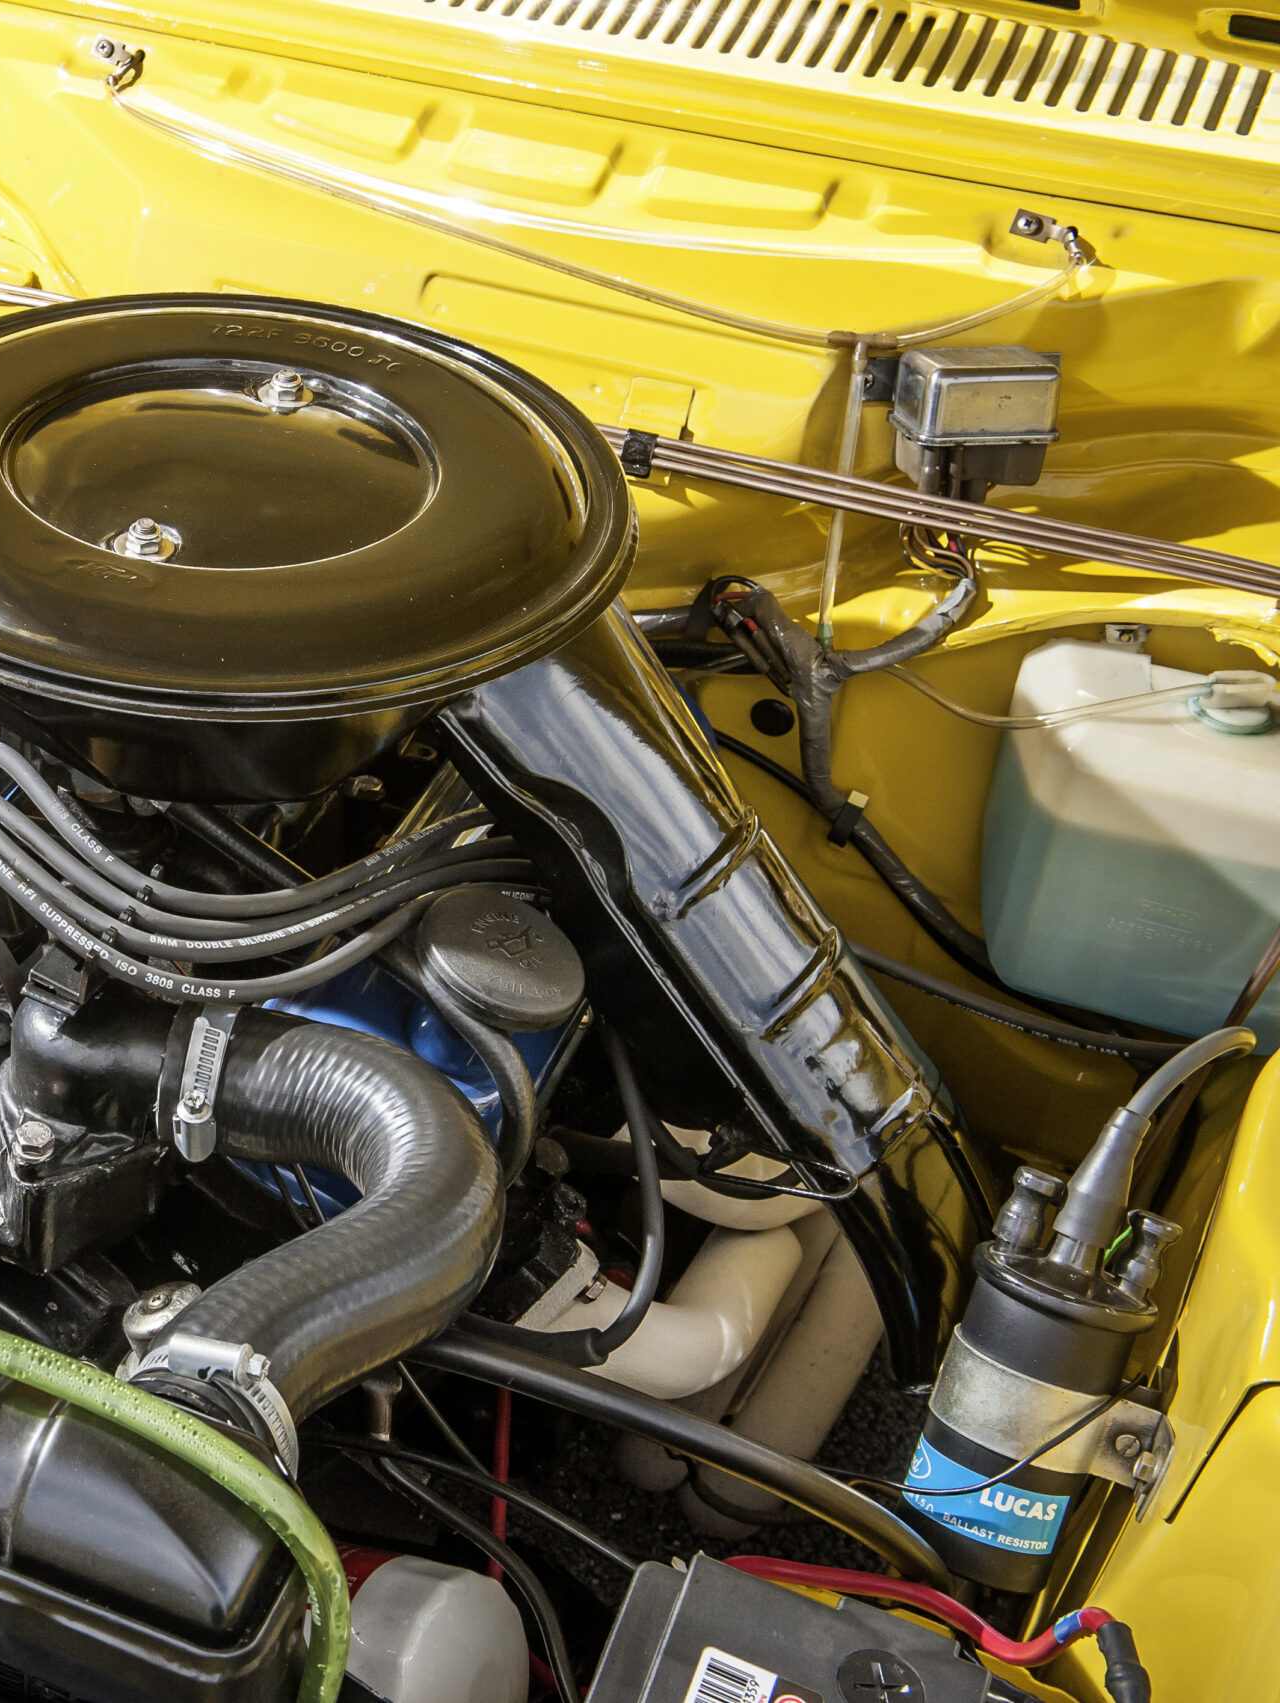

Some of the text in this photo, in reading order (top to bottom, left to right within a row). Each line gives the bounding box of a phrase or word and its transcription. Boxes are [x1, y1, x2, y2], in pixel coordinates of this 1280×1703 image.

[294, 333, 365, 357] 9600
[70, 822, 103, 855] CLASS
[104, 854, 115, 863] F
[381, 839, 412, 857] DOUBLE
[17, 881, 37, 902] RFI
[38, 901, 110, 961] SUPPRESSED
[114, 959, 138, 977] ISO
[144, 973, 174, 990] 3808
[181, 983, 222, 999] CLASS
[228, 989, 236, 999] F
[149, 934, 178, 948] 8MM
[185, 938, 234, 949] DOUBLE
[237, 929, 287, 947] SILICONE
[289, 923, 306, 936] RFI
[978, 1486, 1059, 1522] LUCAS
[941, 1511, 996, 1541] BALLAST
[996, 1533, 1049, 1551] RESISTOR
